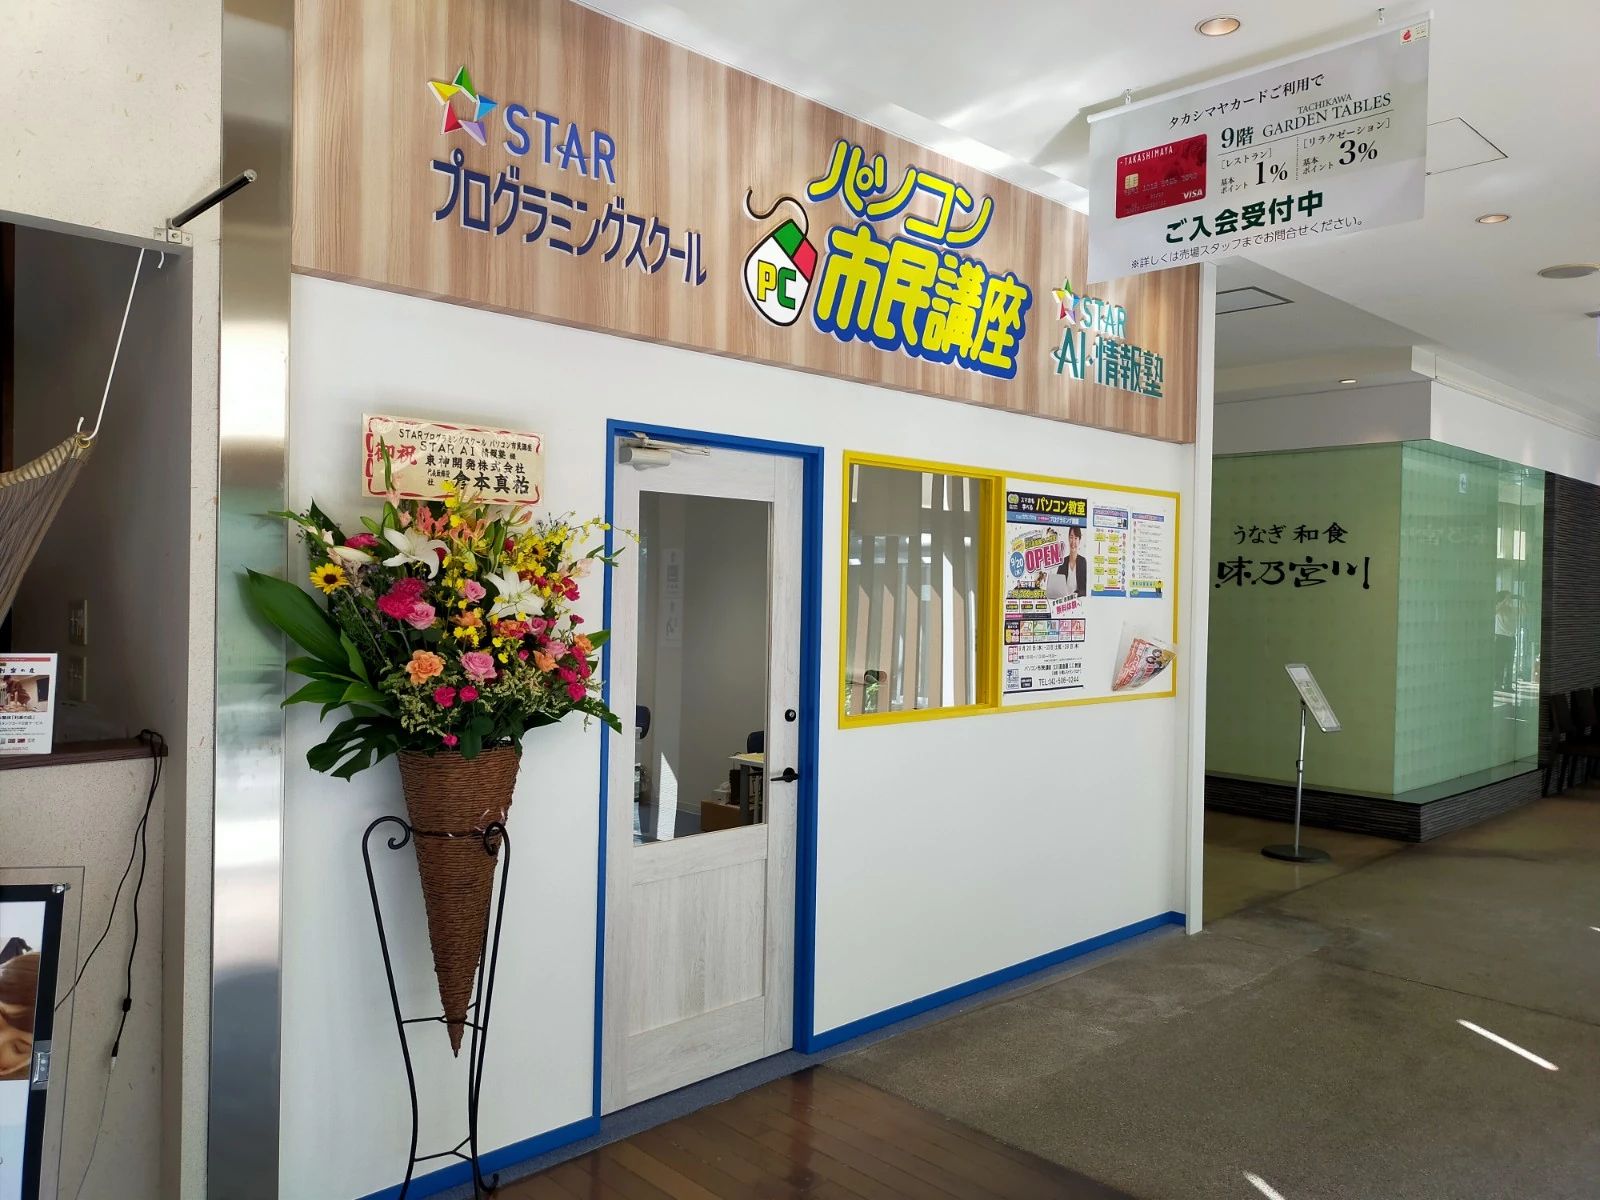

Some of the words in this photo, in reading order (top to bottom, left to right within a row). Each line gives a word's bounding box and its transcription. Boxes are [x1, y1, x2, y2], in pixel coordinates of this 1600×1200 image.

[1168, 73, 1325, 129] タカシマヤカードご利用で
[1298, 93, 1353, 114] TACHIKAWA
[1220, 126, 1254, 149] 9階
[1262, 110, 1328, 138] GARDEN
[1334, 92, 1391, 119] TABLES
[503, 103, 616, 184] STAR
[1124, 146, 1173, 166] TAKASHIMAYA
[1339, 139, 1378, 166] 3%
[1255, 161, 1288, 186] 1%
[1302, 161, 1334, 175] ポイント
[805, 139, 994, 249] パソコン
[1183, 189, 1203, 199] VISA
[1220, 182, 1248, 195] ポイント
[430, 148, 707, 287] プログラミングスクール
[1165, 190, 1324, 244] ご入会受付中
[756, 260, 797, 310] PC
[812, 221, 1033, 380] 市民講座
[1080, 296, 1127, 339] STAR
[420, 441, 455, 455] STAR
[460, 446, 475, 456] AI
[1035, 496, 1086, 516] パソコン教室
[1233, 524, 1287, 545] うなぎ
[1293, 522, 1349, 544] 和食
[1214, 556, 1370, 590] 味乃宮川
